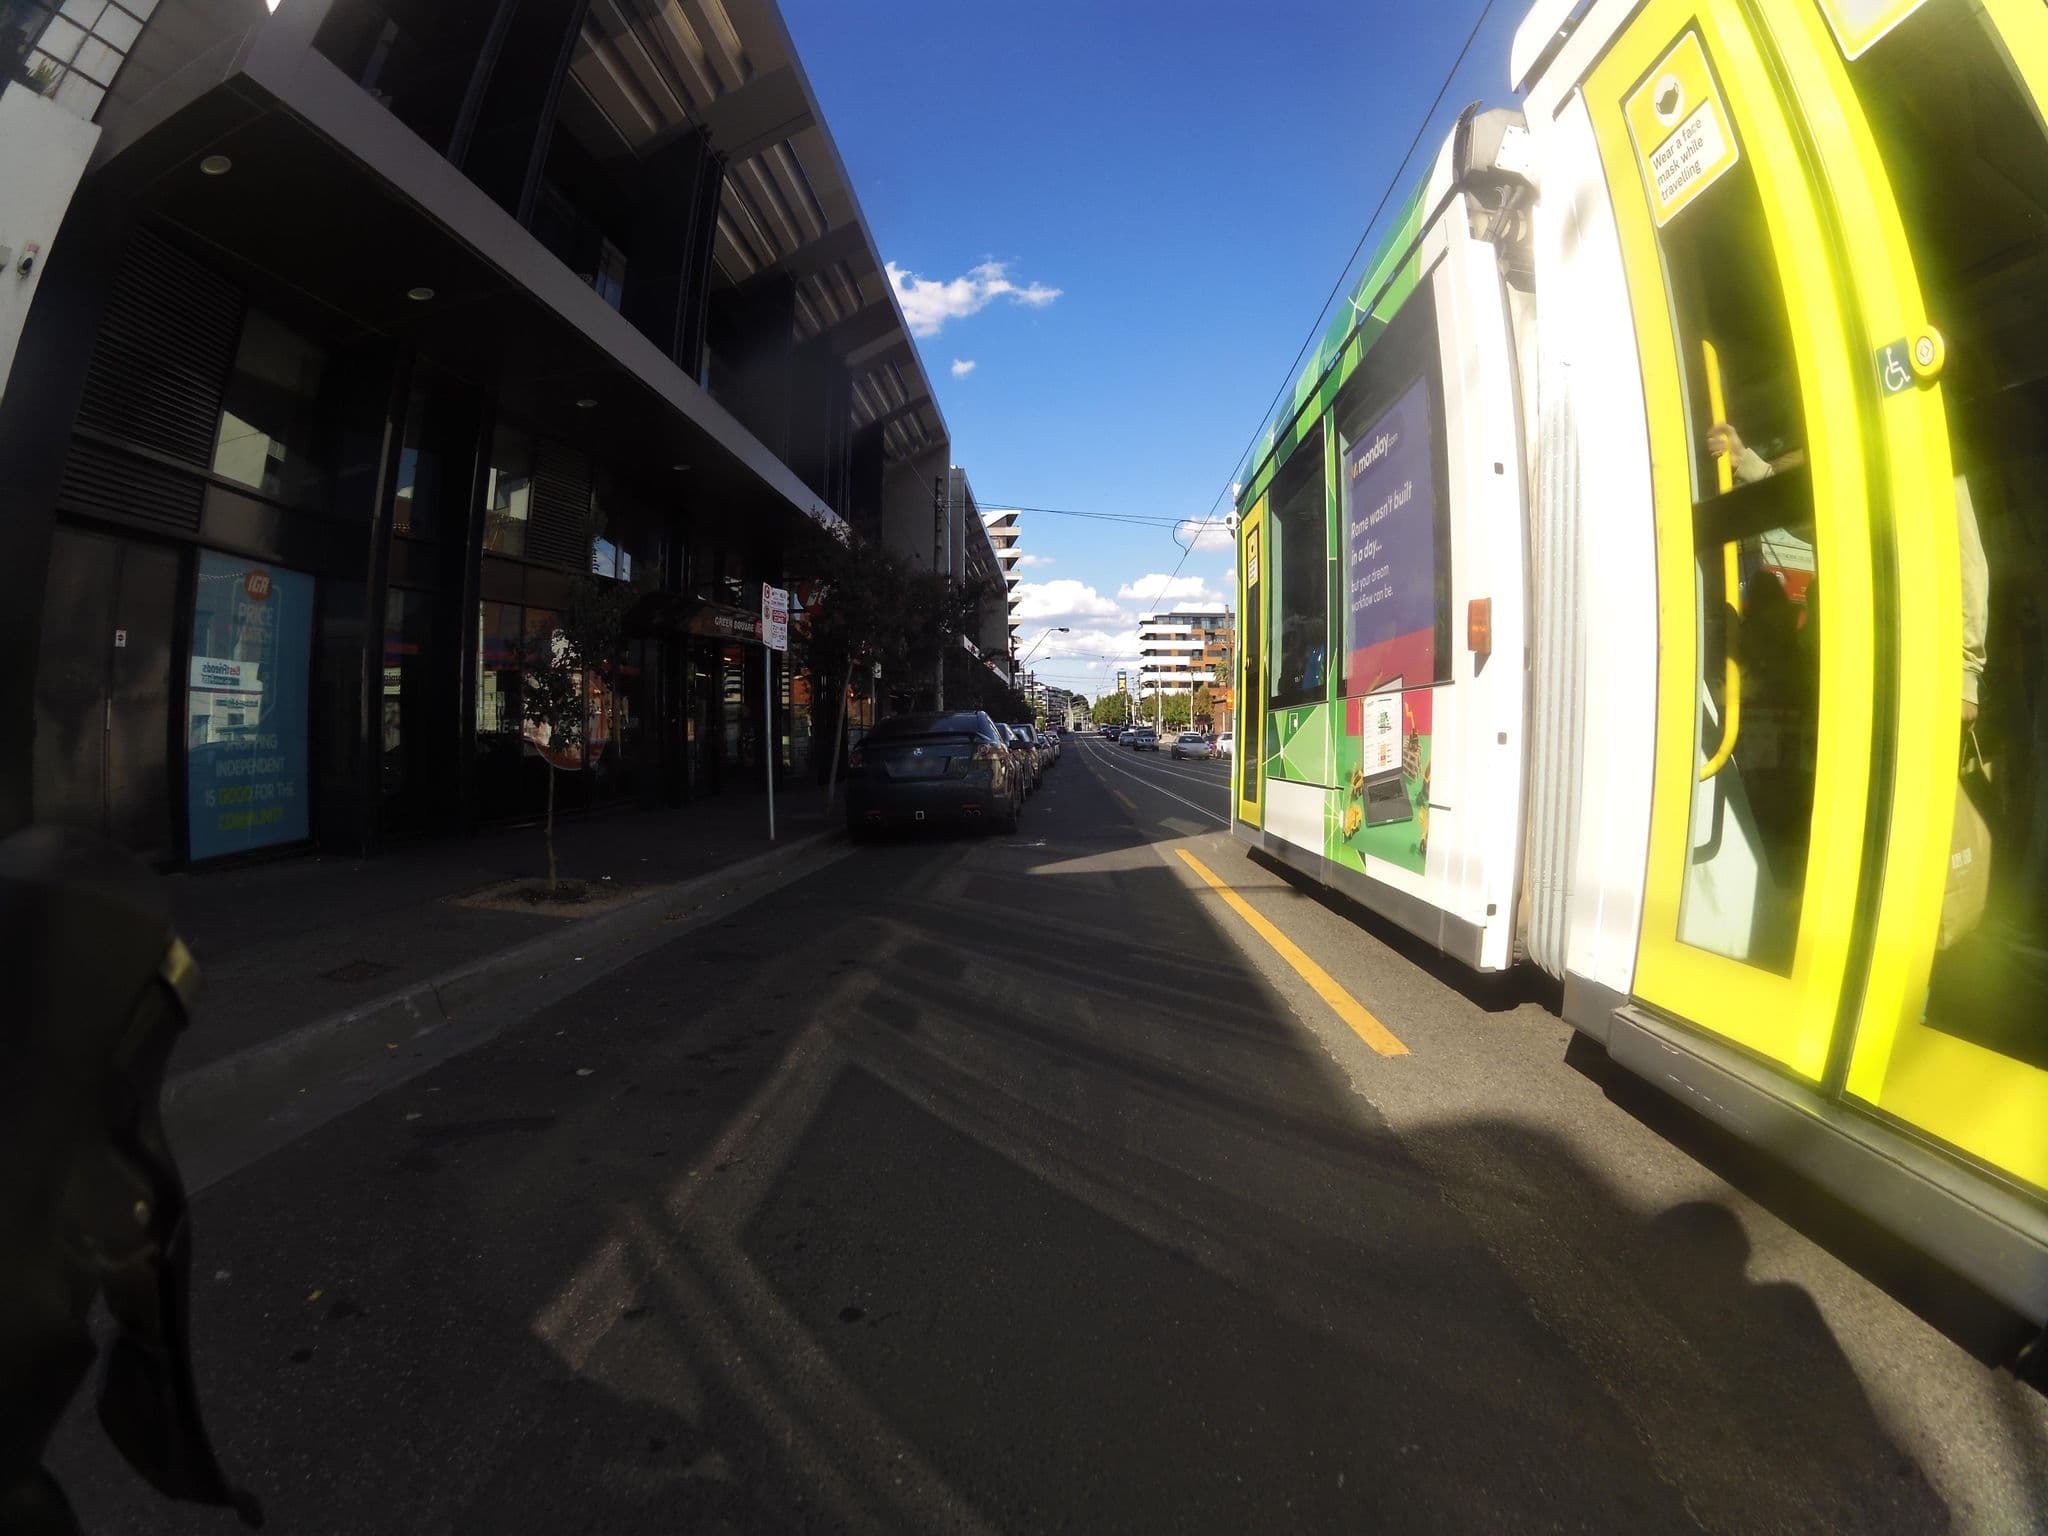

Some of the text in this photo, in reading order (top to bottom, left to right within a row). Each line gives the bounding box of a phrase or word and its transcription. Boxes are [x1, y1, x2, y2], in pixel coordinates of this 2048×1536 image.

[1653, 119, 1702, 170] Wear a face
[1658, 137, 1703, 186] mask while
[1661, 160, 1701, 200] travelling
[1351, 480, 1412, 540] Rome wasn't built
[1352, 549, 1358, 567] in
[1358, 549, 1363, 562] a
[1351, 563, 1390, 593] but your dream
[1374, 590, 1384, 603] can
[215, 757, 285, 777] INDEPENDENT
[206, 789, 216, 809] IS
[255, 783, 274, 801] FOR
[277, 780, 296, 798] THE
